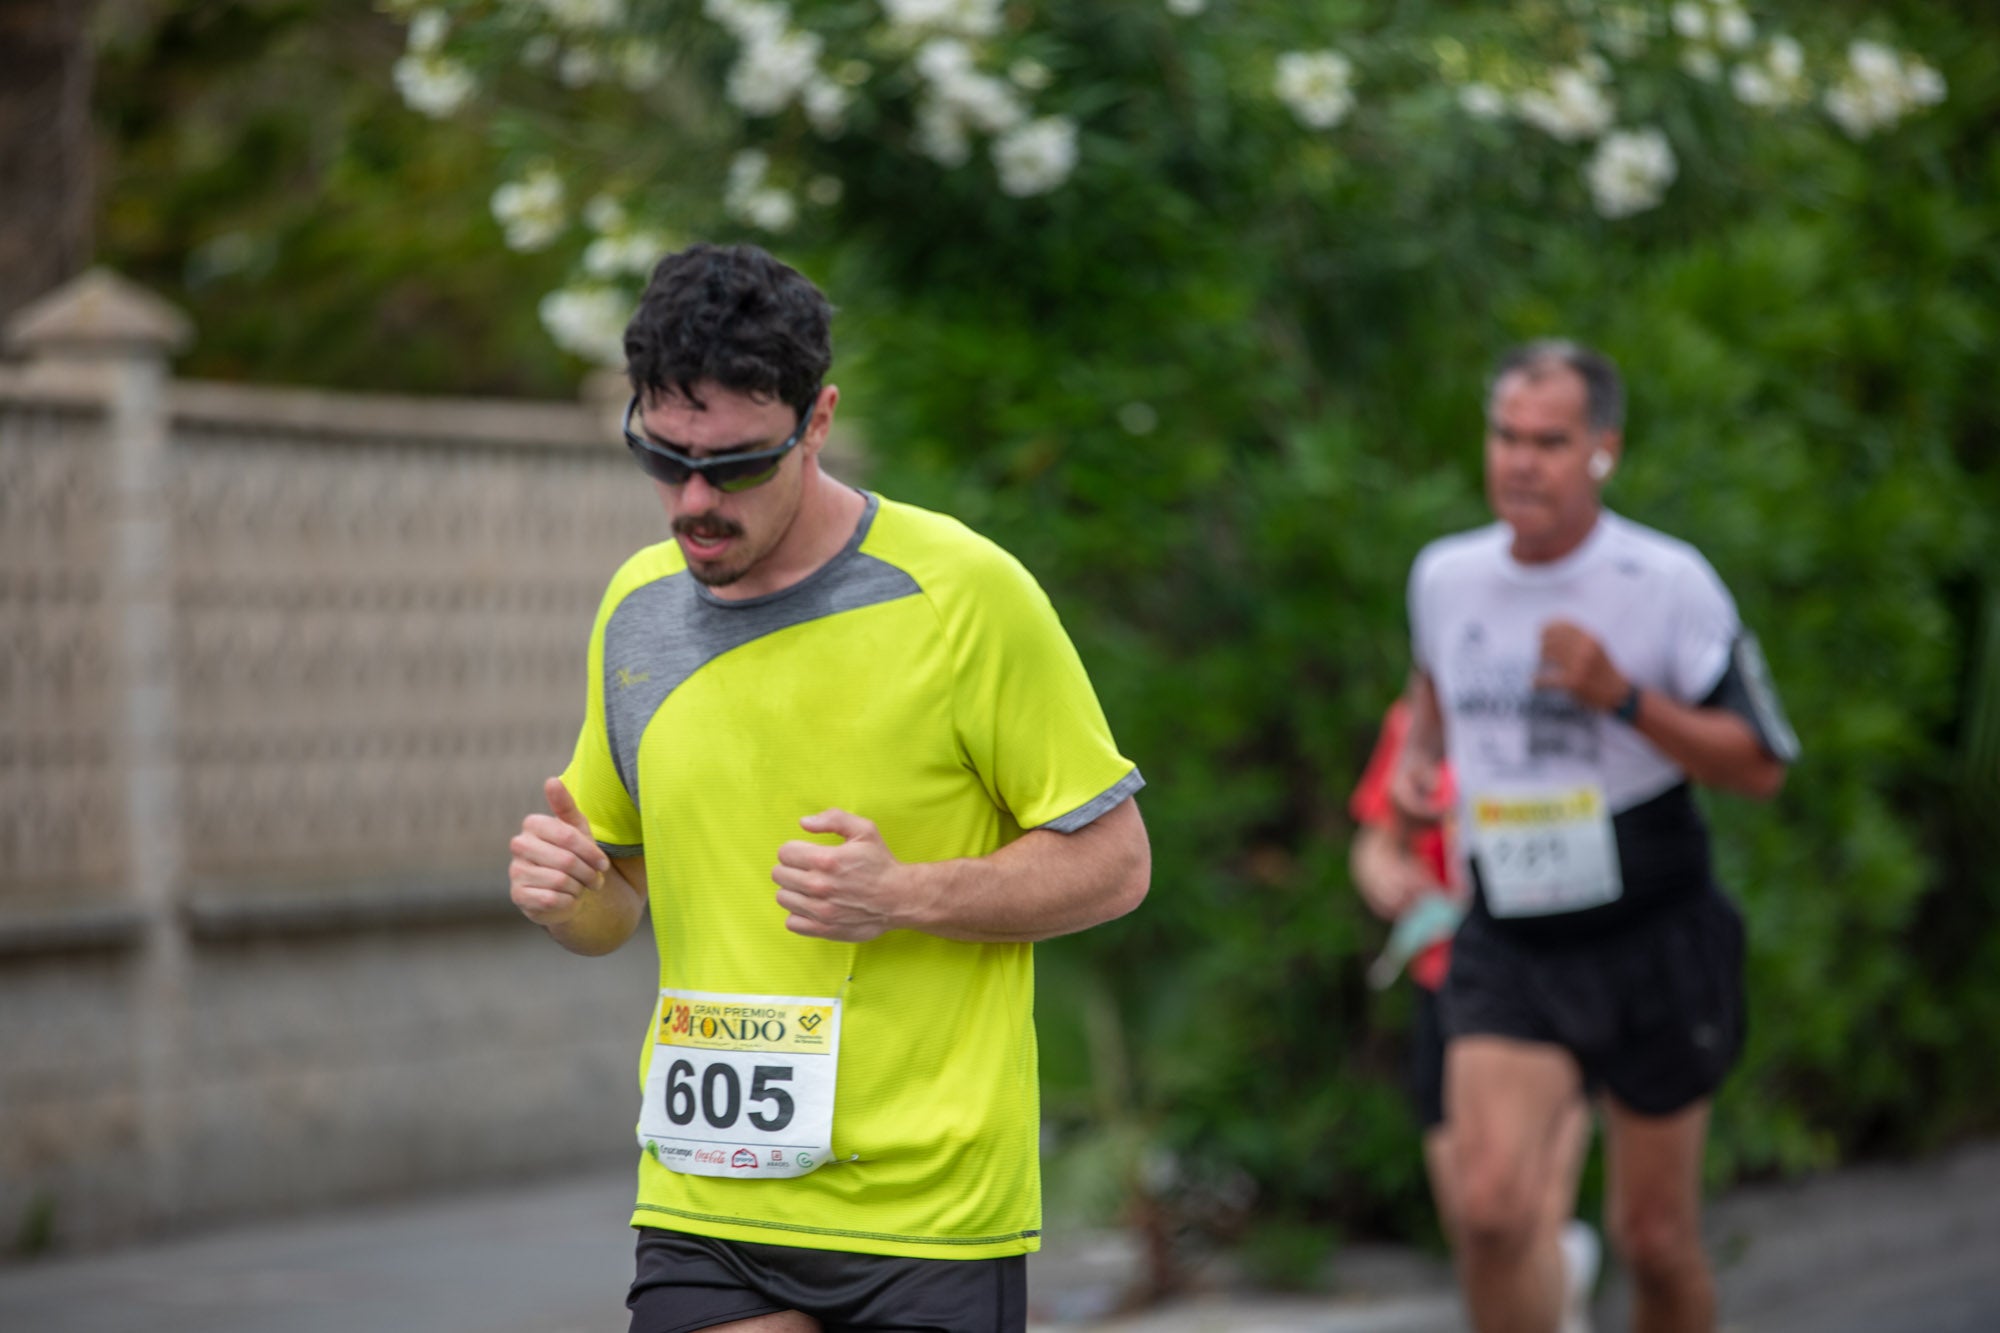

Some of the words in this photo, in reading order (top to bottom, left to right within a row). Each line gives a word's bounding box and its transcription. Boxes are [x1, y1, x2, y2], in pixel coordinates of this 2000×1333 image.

[671, 1004, 690, 1034] 38
[694, 1005, 720, 1016] GRAN
[724, 1007, 776, 1018] PREMIO
[688, 1015, 786, 1042] FONDO
[665, 1059, 795, 1132] 605
